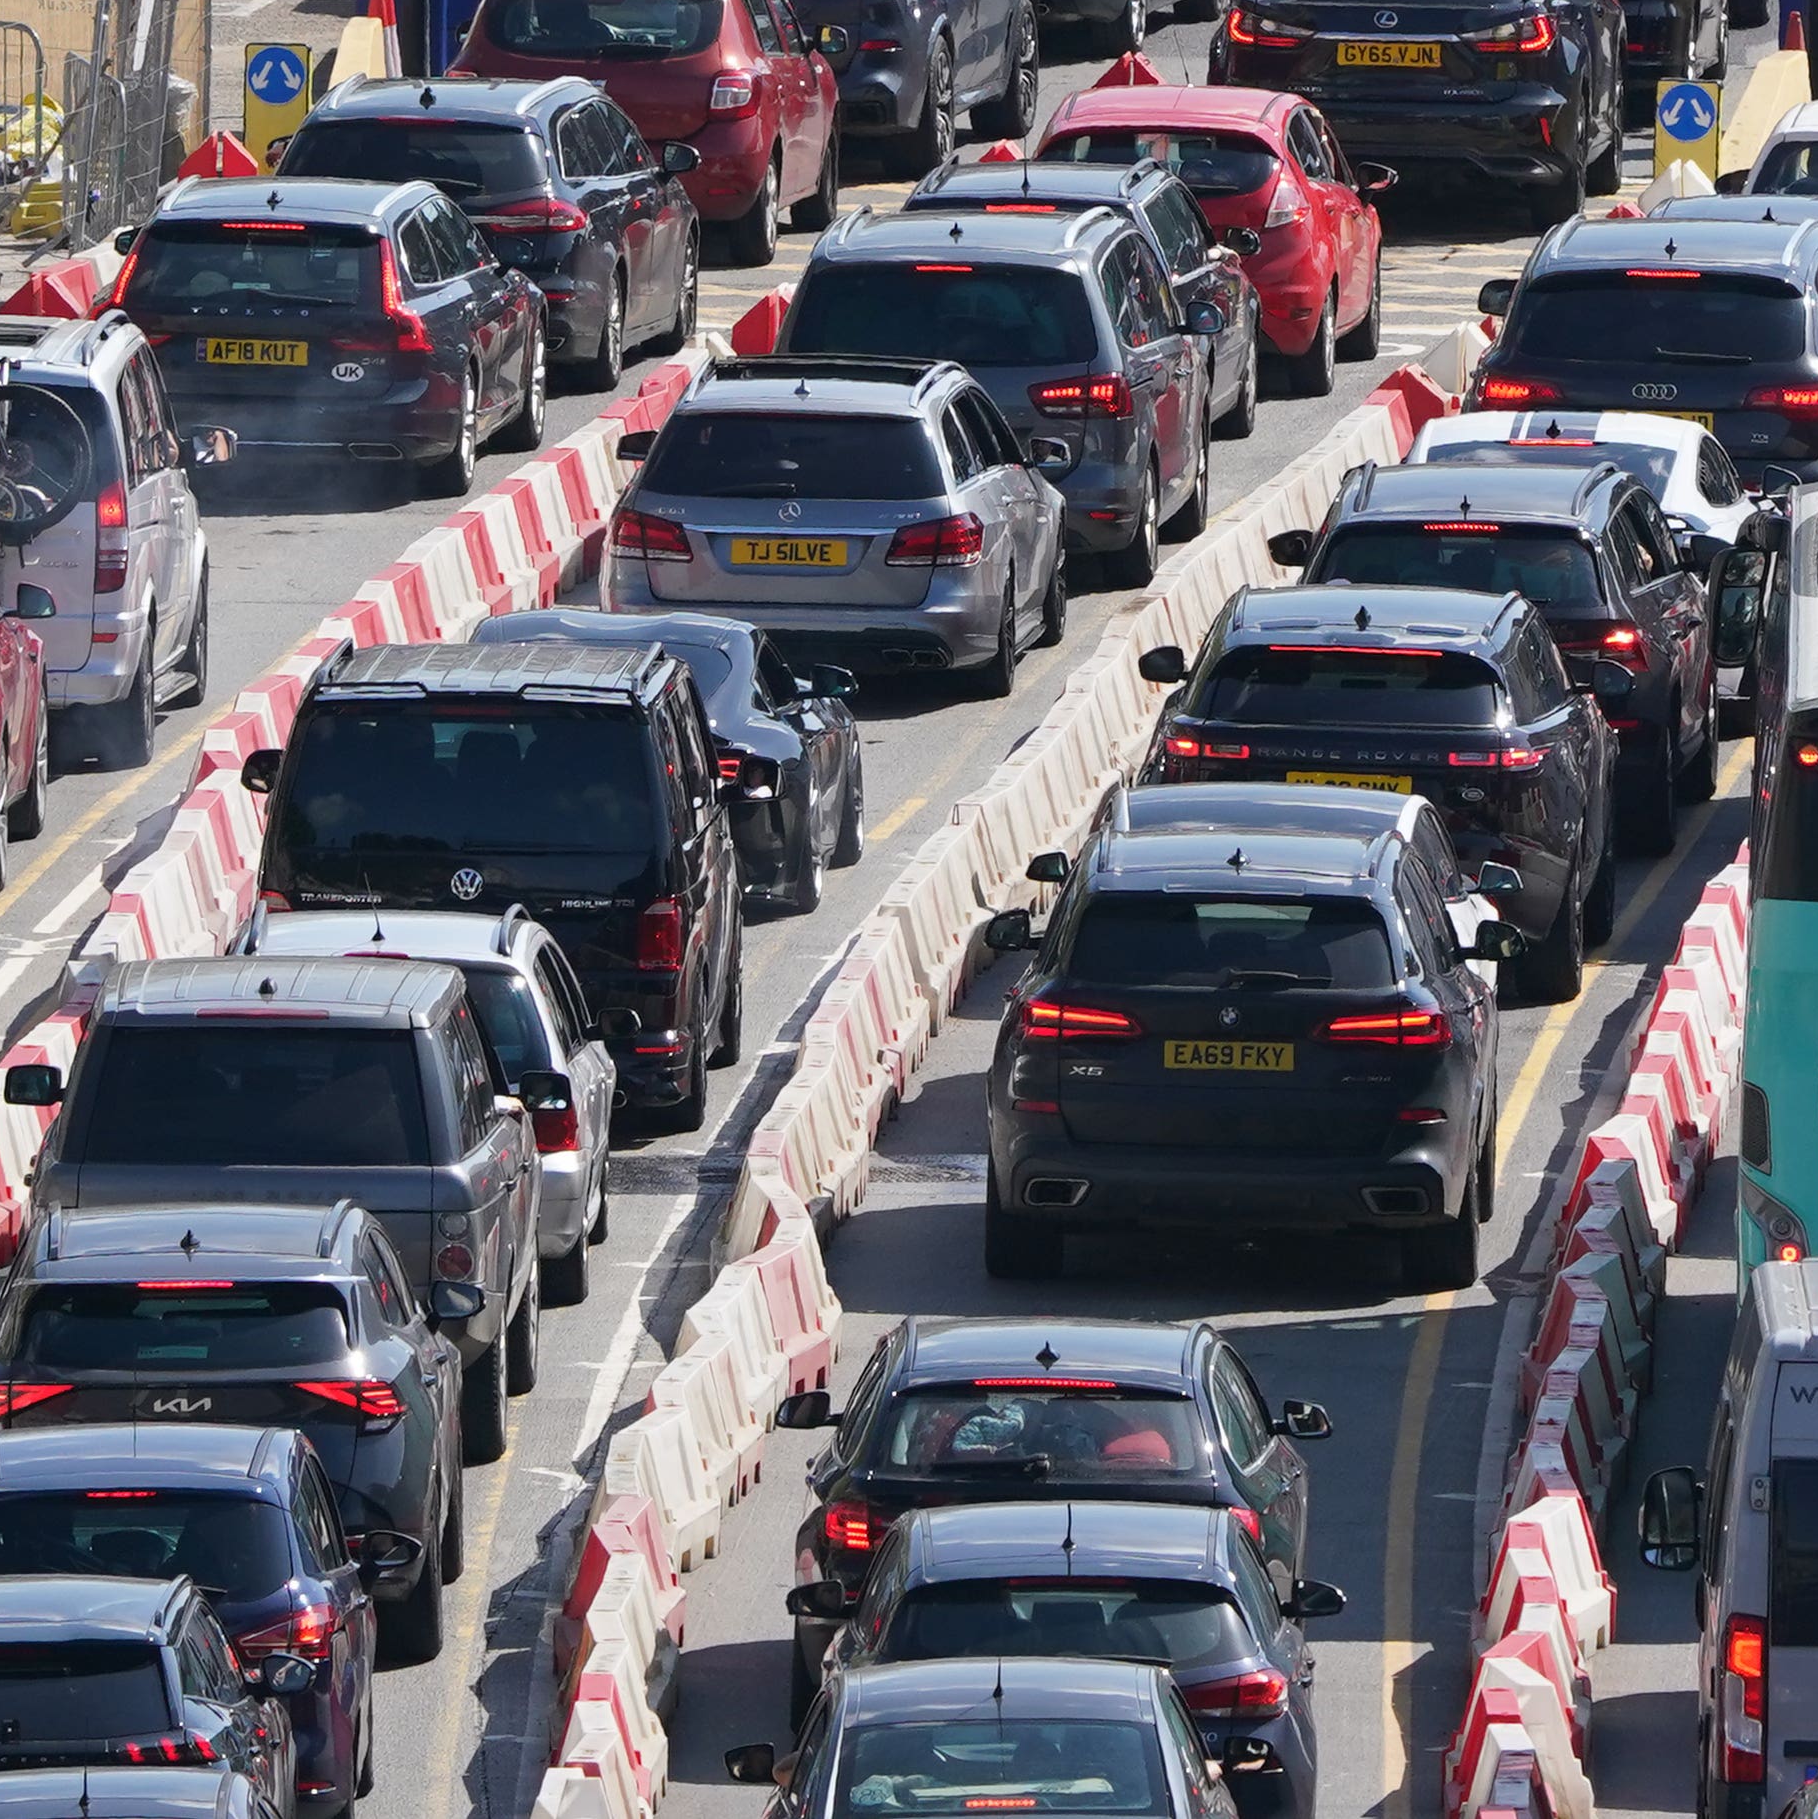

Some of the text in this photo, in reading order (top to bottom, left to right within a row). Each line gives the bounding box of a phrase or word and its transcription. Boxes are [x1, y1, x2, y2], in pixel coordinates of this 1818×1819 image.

[1344, 43, 1435, 66] GY65 VJN
[190, 307, 311, 318] VOLVO
[211, 340, 301, 364] AF18 KUT
[334, 364, 362, 380] UK
[746, 542, 773, 562] TJ
[1257, 747, 1440, 764] RANGE ROVER
[299, 892, 383, 905] TRANSPORTER
[1173, 1044, 1291, 1068] EA69 FKY
[1068, 1065, 1105, 1076] X5
